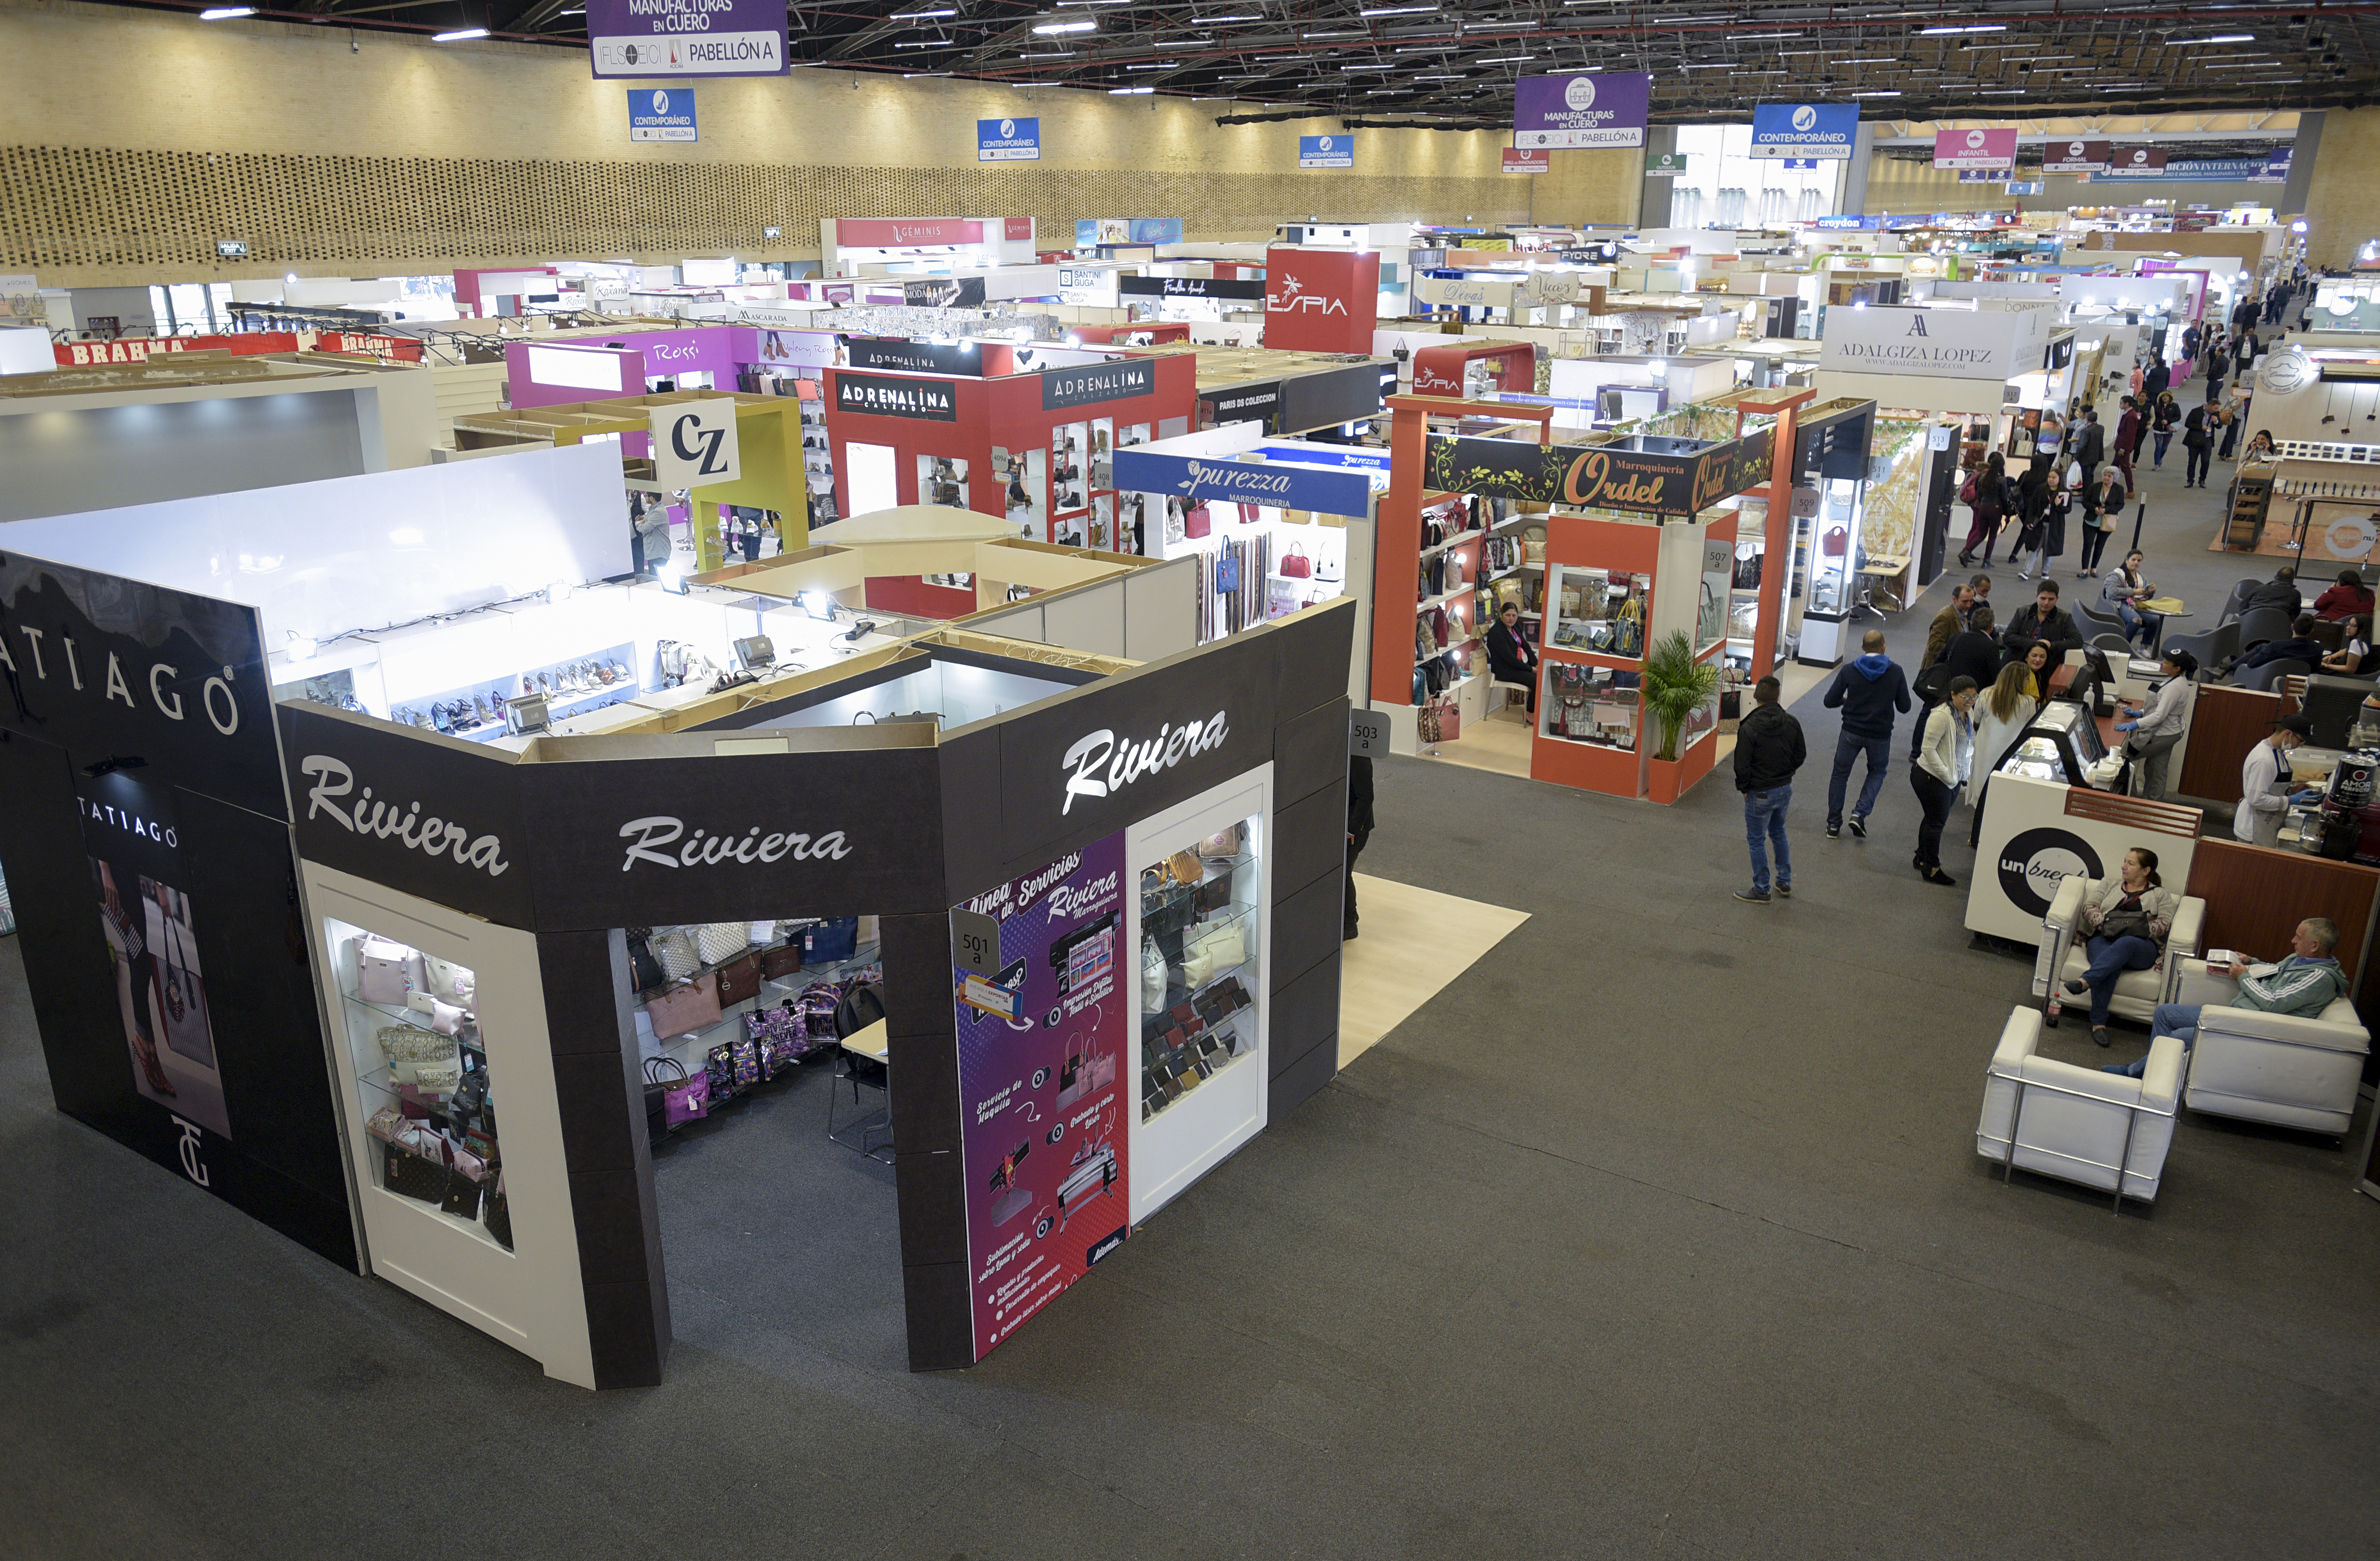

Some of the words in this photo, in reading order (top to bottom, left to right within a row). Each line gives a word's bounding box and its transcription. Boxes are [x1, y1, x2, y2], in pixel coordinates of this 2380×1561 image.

[630, 0, 732, 15] MANUFACTURAS
[653, 21, 665, 32] EN
[667, 14, 710, 32] CUERO
[689, 37, 760, 61] PABELLÓN
[762, 41, 774, 59] A
[635, 116, 690, 125] CONTEMPORÁNEO
[1544, 110, 1614, 121] MANUFACTURAS
[1568, 120, 1598, 128] CUERO
[983, 138, 1035, 148] CONTEMPORÁNEO
[1581, 130, 1628, 142] PABELLÓN
[1630, 132, 1637, 141] A
[1759, 131, 1846, 143] CONTEMPORÁNEO
[1803, 146, 1838, 155] PABELLÓN
[2166, 161, 2200, 171] BICIÓN
[902, 225, 941, 236] GÉMINIS
[1819, 217, 1860, 229] croydon
[1561, 251, 1598, 260] FYORE
[1074, 270, 1101, 280] SANTINI
[596, 285, 628, 296] Roxana
[906, 289, 927, 299] MODA
[1443, 281, 1485, 300] Divas
[565, 296, 586, 306] Roxa
[1267, 294, 1348, 316] ESPIA
[737, 310, 787, 322] MASCARADA
[72, 340, 184, 365] BRAHMA
[341, 335, 394, 357] BRAHMA
[782, 340, 811, 357] Valery
[1839, 343, 1928, 360] ADALGIZA
[1934, 347, 1992, 364] LOPEZ
[869, 353, 935, 367] ADRENALINA
[1865, 358, 1966, 370] WWW.ADALGIZALOPEZ.COM
[1054, 368, 1145, 398] ADRENALINA
[1414, 377, 1460, 391] ESPIA
[843, 384, 949, 408] ADRENALINA
[1074, 388, 1127, 401] CALZADO
[1219, 400, 1236, 411] PARIS
[1237, 399, 1244, 408] DS
[1245, 393, 1276, 408] COLECCION
[864, 401, 927, 413] CALZADO
[672, 413, 728, 476] CZ
[1346, 455, 1381, 467] purezza
[1616, 460, 1684, 475] Marroquineria
[1098, 472, 1110, 481] 408
[1873, 465, 1885, 474] 511
[1188, 465, 1292, 496] purezza
[1565, 451, 1665, 505] Ordel
[1691, 454, 1726, 513] Ordel
[1229, 493, 1291, 509] MARROQUINERIA
[1599, 501, 1619, 509] Diseño
[1624, 503, 1656, 513] Innovación
[1665, 506, 1688, 516] Calidad
[1799, 498, 1815, 506] 509
[1710, 551, 1726, 561] 507
[1354, 725, 1378, 739] 503
[1362, 740, 1369, 749] a
[1062, 709, 1230, 816] Riviera
[2340, 784, 2371, 793] PERFECTO
[2342, 779, 2371, 788] AMOR
[77, 796, 178, 847] TATIAGO
[301, 755, 509, 876] Riviera
[619, 815, 853, 872] Riviera
[2001, 858, 2024, 874] un
[1001, 901, 1015, 920] de
[1018, 851, 1081, 906] Servicios
[1047, 870, 1118, 924] Riviera
[1073, 891, 1118, 920] Marroquinera
[962, 933, 988, 954] 501
[973, 951, 981, 964] a
[988, 991, 1009, 1001] EXPORTAR
[1063, 986, 1092, 1010] Impresión
[1093, 973, 1114, 992] Digital
[1069, 1000, 1085, 1017] Textil
[1089, 984, 1114, 1005] Sintético
[764, 1021, 796, 1034] RIVIERA
[769, 1029, 797, 1043] OREVER
[977, 1087, 1011, 1115] Servicio
[1013, 1080, 1022, 1092] de
[978, 1097, 1011, 1125] Maquila
[1070, 1106, 1095, 1129] Grabado
[1100, 1093, 1115, 1108] corte
[1085, 1113, 1101, 1130] Láser
[986, 1232, 1025, 1266] Sublimación
[1092, 1236, 1123, 1264] Además...
[978, 1266, 995, 1284] sobre
[995, 1254, 1011, 1273] Lona
[1016, 1238, 1031, 1254] seda
[997, 1278, 1016, 1297] Regalos
[1021, 1254, 1045, 1278] productos
[997, 1275, 1031, 1307] institucionales
[1005, 1290, 1030, 1314] Desarrollo
[1030, 1283, 1037, 1291] de
[1037, 1263, 1061, 1288] empaques
[1001, 1315, 1022, 1337] Grabado
[1022, 1306, 1035, 1318] láser
[1035, 1295, 1047, 1309] sobre
[1047, 1281, 1062, 1300] metal
